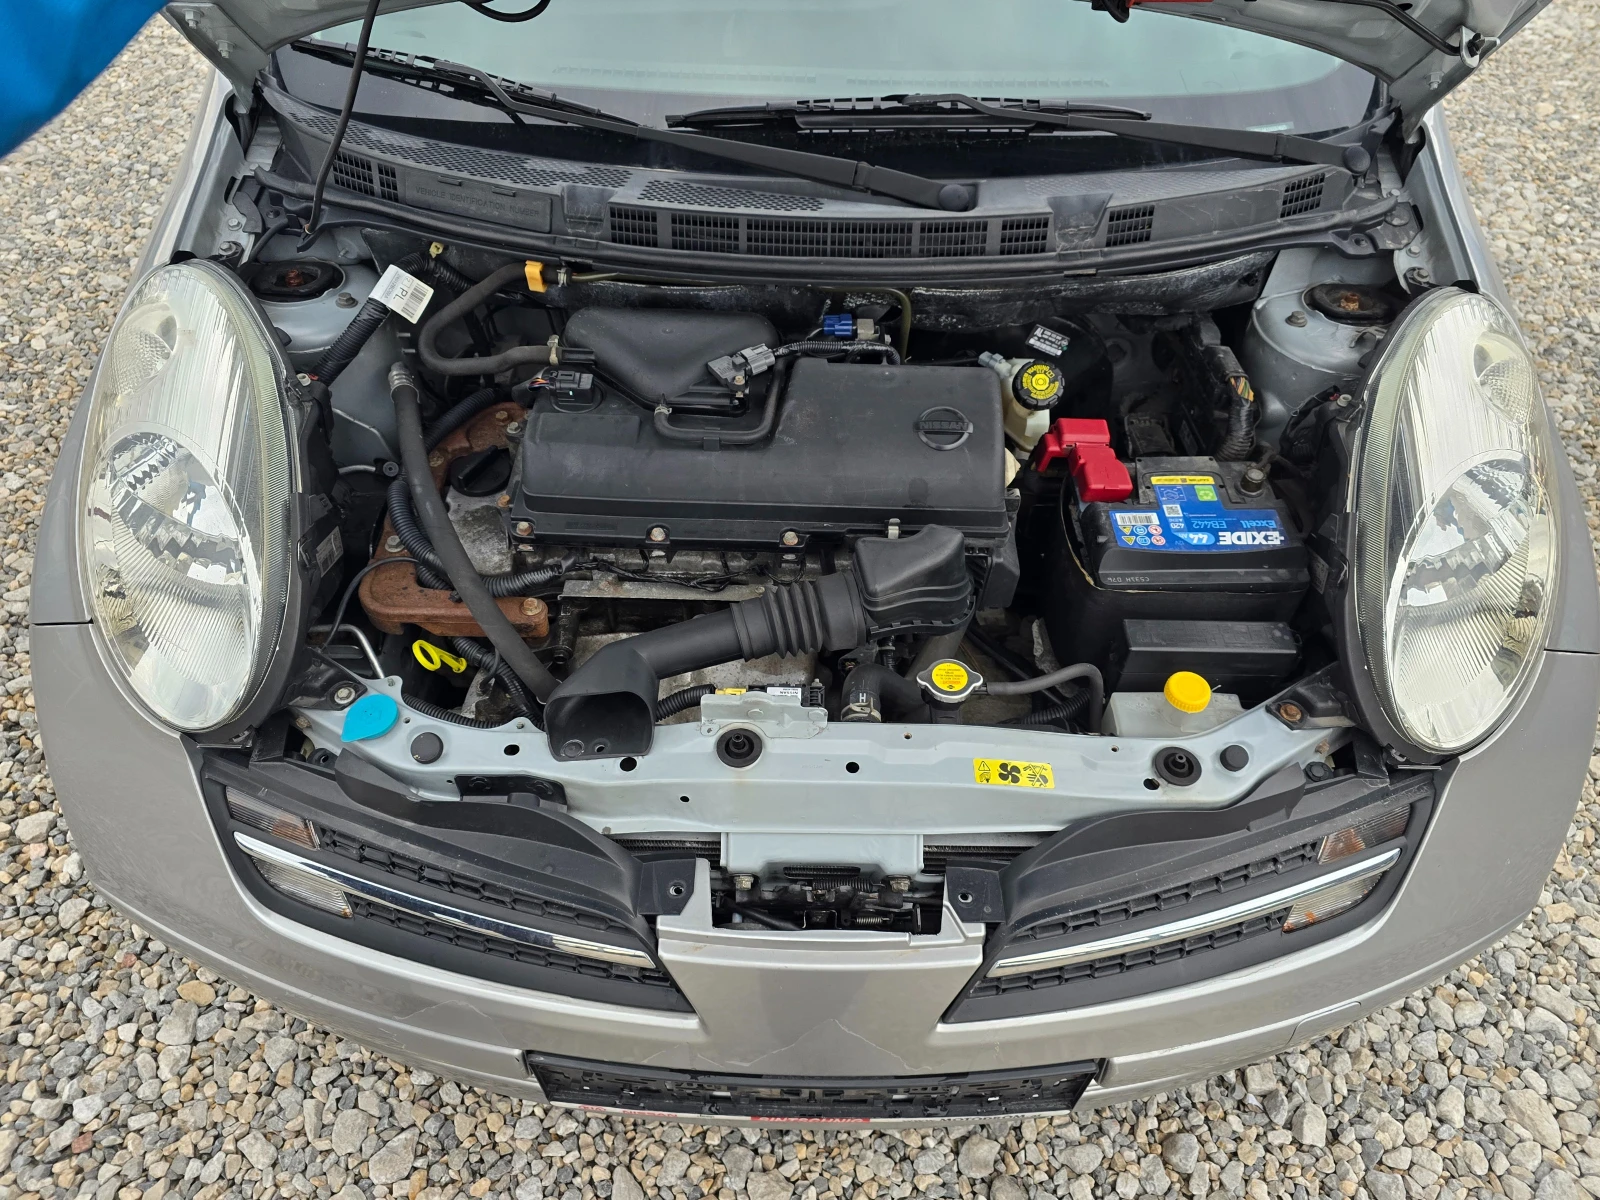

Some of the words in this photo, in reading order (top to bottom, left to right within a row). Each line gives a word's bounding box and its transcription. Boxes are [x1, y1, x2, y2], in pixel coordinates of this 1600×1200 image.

[415, 187, 446, 199] VEHICLE
[449, 193, 506, 211] IDENTIFICATION
[509, 205, 540, 217] NUMBER
[920, 421, 968, 430] NISSAN
[1191, 520, 1228, 529] EB442
[1240, 519, 1277, 528] Excell
[1218, 531, 1285, 545] EXIDE
[859, 692, 867, 703] H
